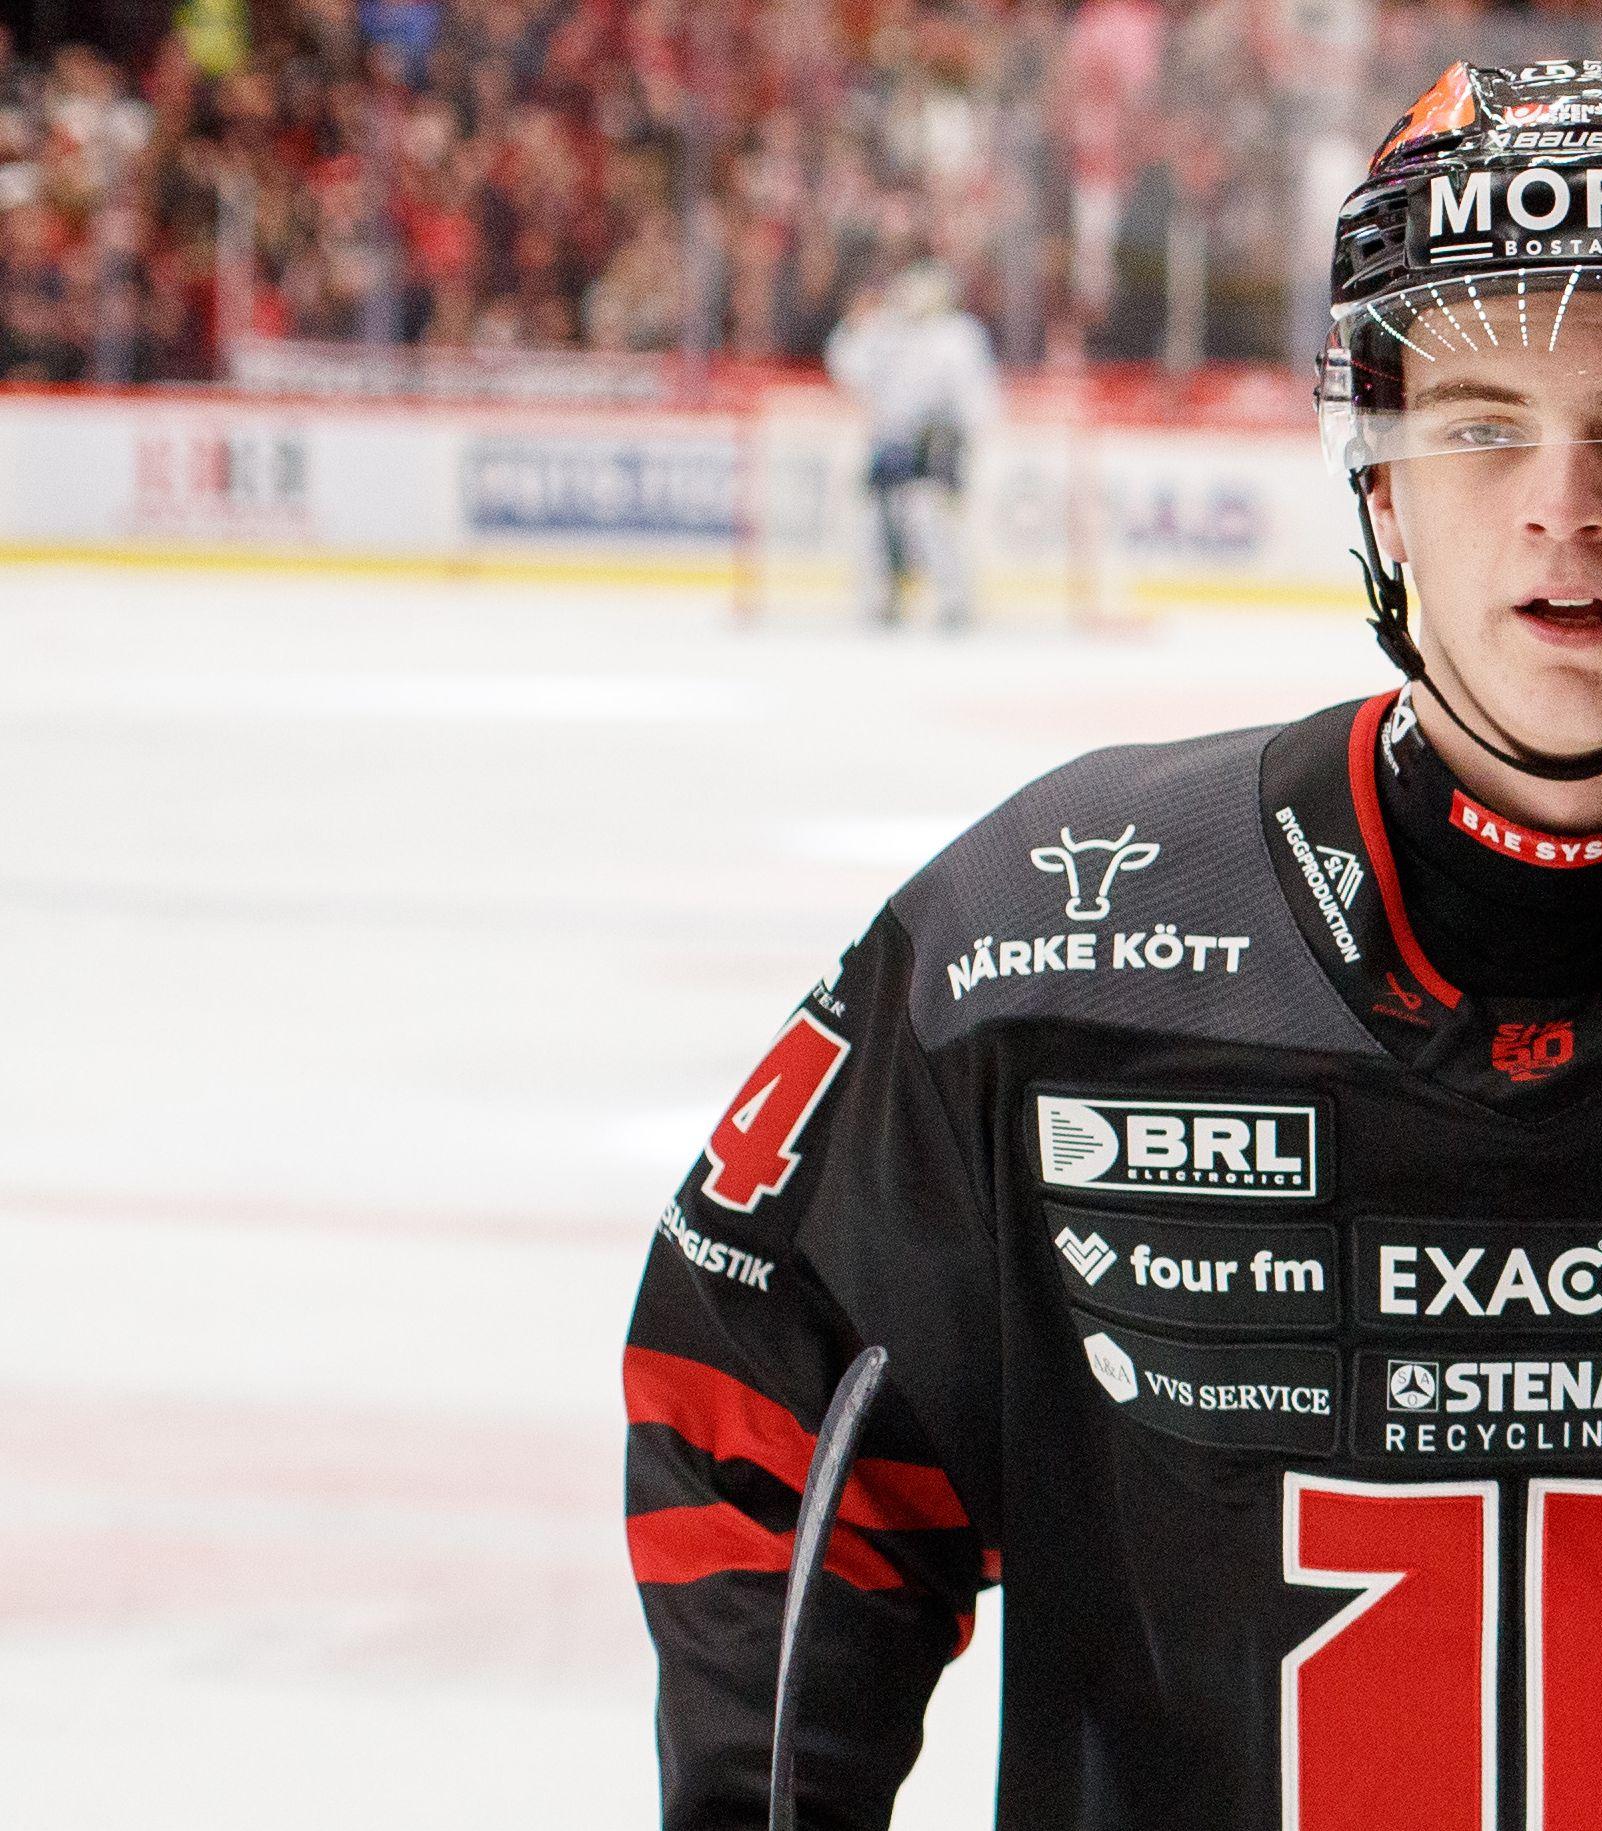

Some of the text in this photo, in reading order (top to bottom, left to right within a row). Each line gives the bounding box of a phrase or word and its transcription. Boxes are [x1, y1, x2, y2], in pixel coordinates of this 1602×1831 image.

[1462, 806, 1521, 852] BAE
[1274, 806, 1362, 964] BYGGPRODUKTION
[946, 923, 1250, 1001] NÄRKE KÖTT
[1126, 1115, 1303, 1173] BRL
[1127, 1168, 1303, 1185] ELECTRONICS
[1130, 1244, 1325, 1293] four fm
[1144, 1371, 1331, 1416] VVS SERVICE
